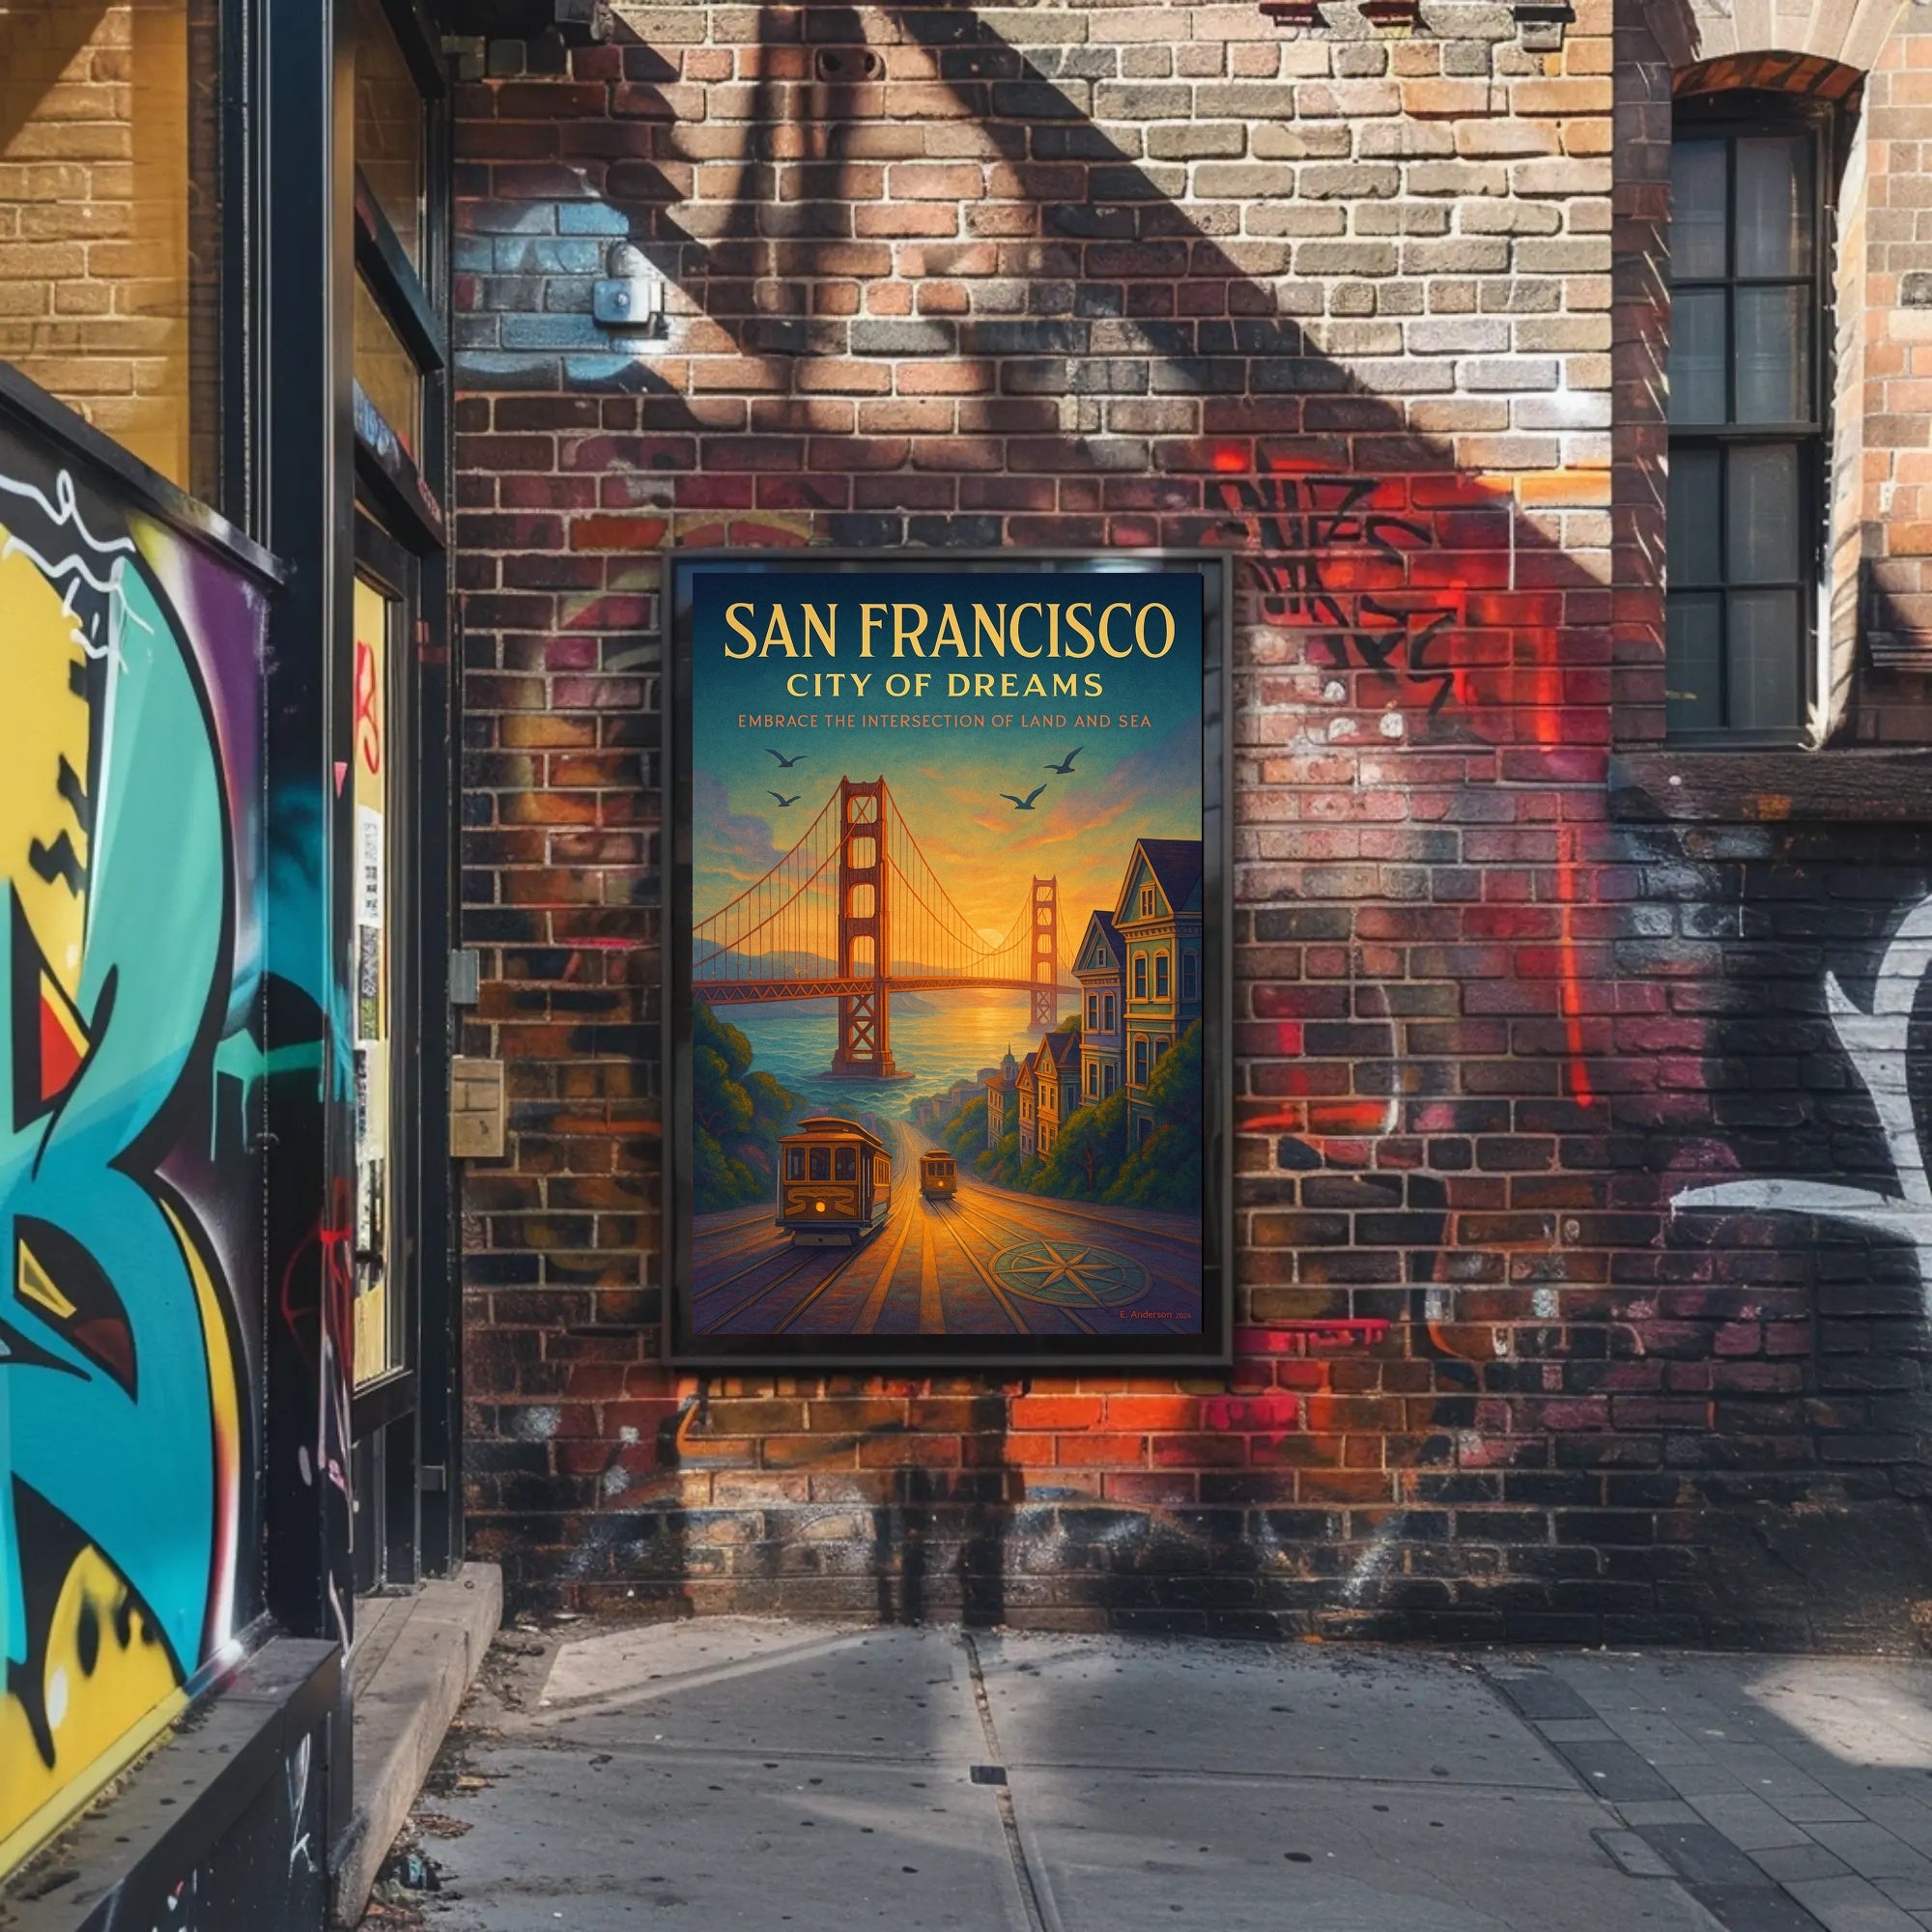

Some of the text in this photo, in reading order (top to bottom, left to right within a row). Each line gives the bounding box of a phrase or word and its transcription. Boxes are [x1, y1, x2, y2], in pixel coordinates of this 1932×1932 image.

[724, 602, 1176, 659] SAN FRANCISCO
[786, 673, 1103, 697] CITY OF DREAMS
[738, 714, 1151, 727] EMBRACE THE INTERSECTION OF LAND AND SEA
[1120, 1310, 1128, 1319] E.
[1130, 1310, 1173, 1319] Anderson
